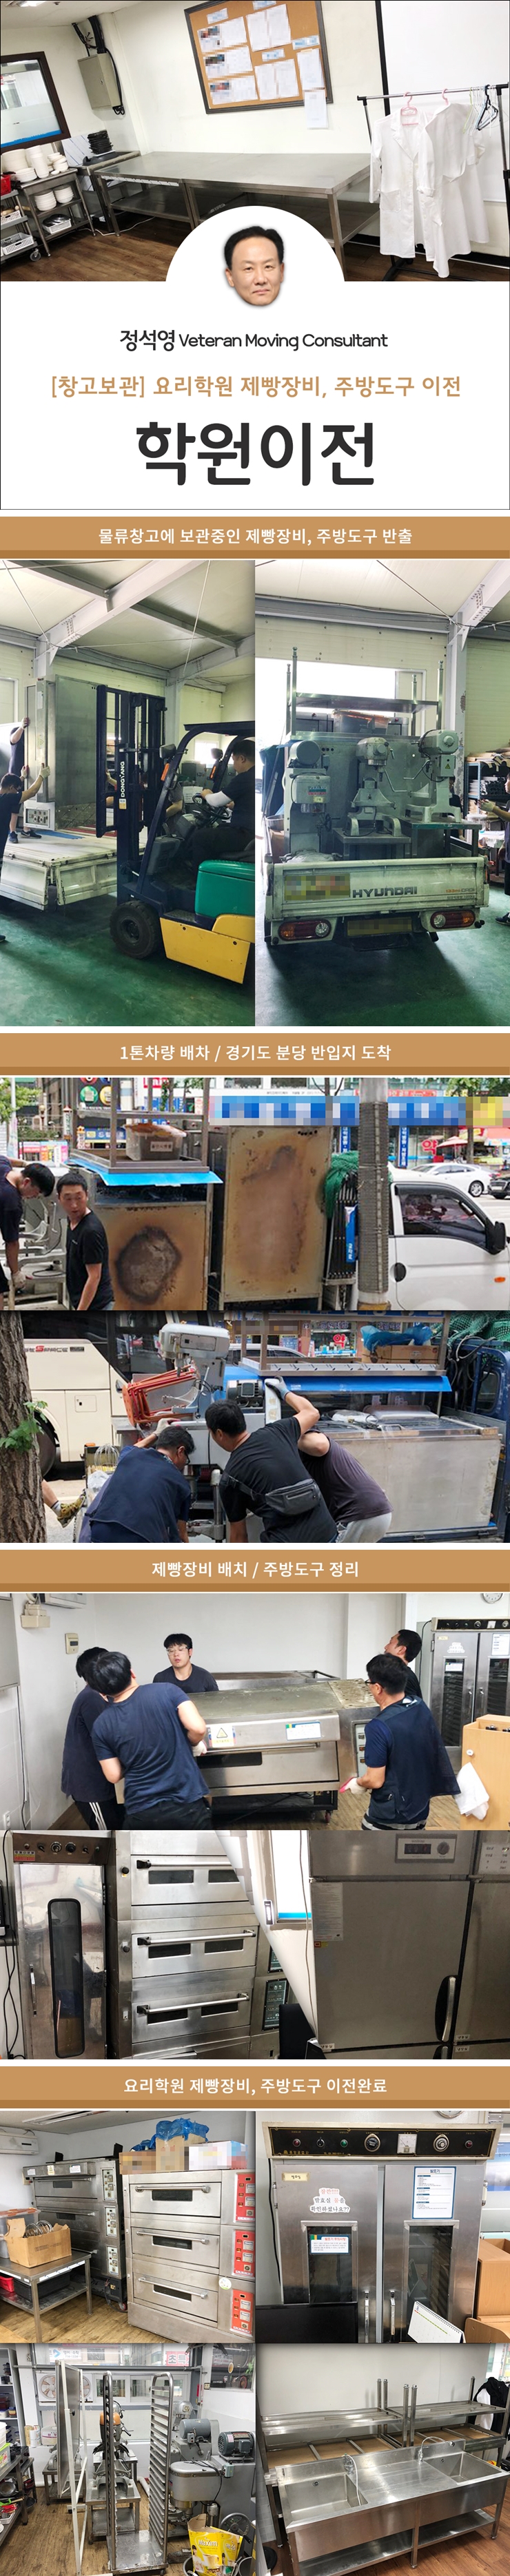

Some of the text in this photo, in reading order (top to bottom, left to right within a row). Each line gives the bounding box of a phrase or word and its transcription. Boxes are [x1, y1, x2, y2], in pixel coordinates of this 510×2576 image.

[353, 886, 417, 898] HYUNDAI
[421, 1139, 438, 1155] 약
[333, 1334, 347, 1348] 약
[198, 2538, 218, 2546] Maxim
